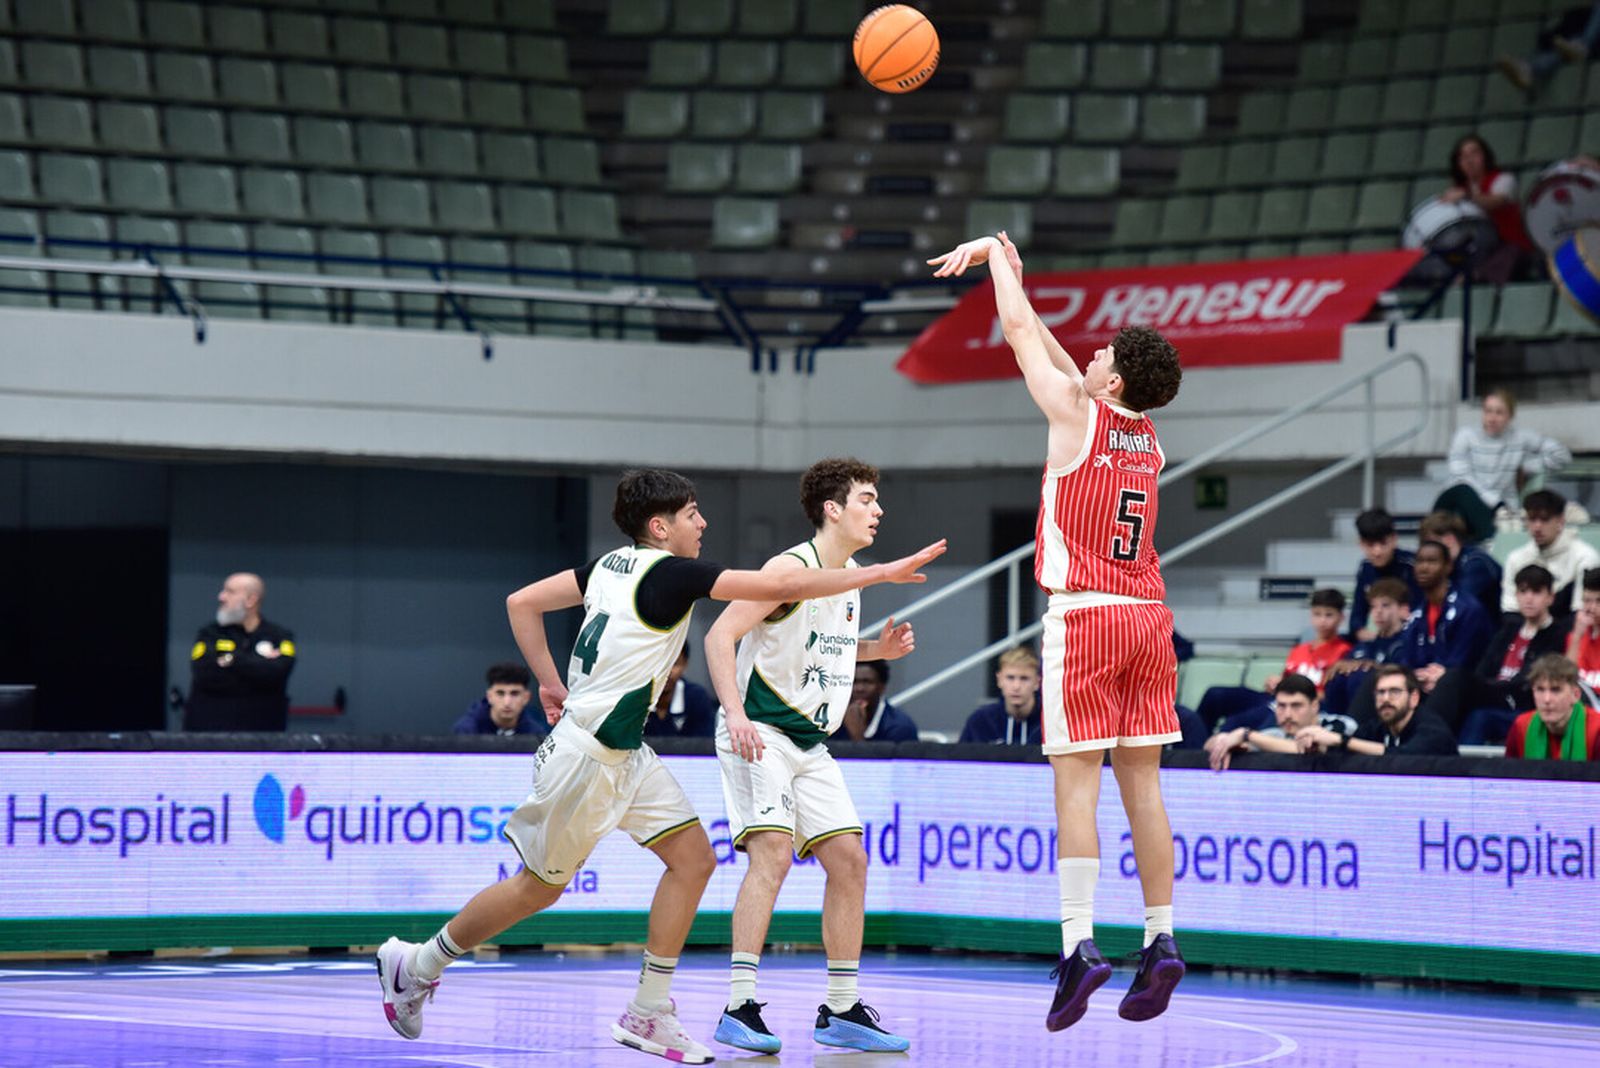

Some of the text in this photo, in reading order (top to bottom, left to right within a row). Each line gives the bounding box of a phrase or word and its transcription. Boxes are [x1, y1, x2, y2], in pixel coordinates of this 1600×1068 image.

[1085, 278, 1344, 330] Renesur
[1112, 488, 1147, 561] 5
[573, 611, 610, 676] 4
[813, 702, 830, 730] 4
[6, 794, 229, 858] Hospital
[304, 796, 515, 861] quirónsa
[1419, 819, 1596, 889] Hospital
